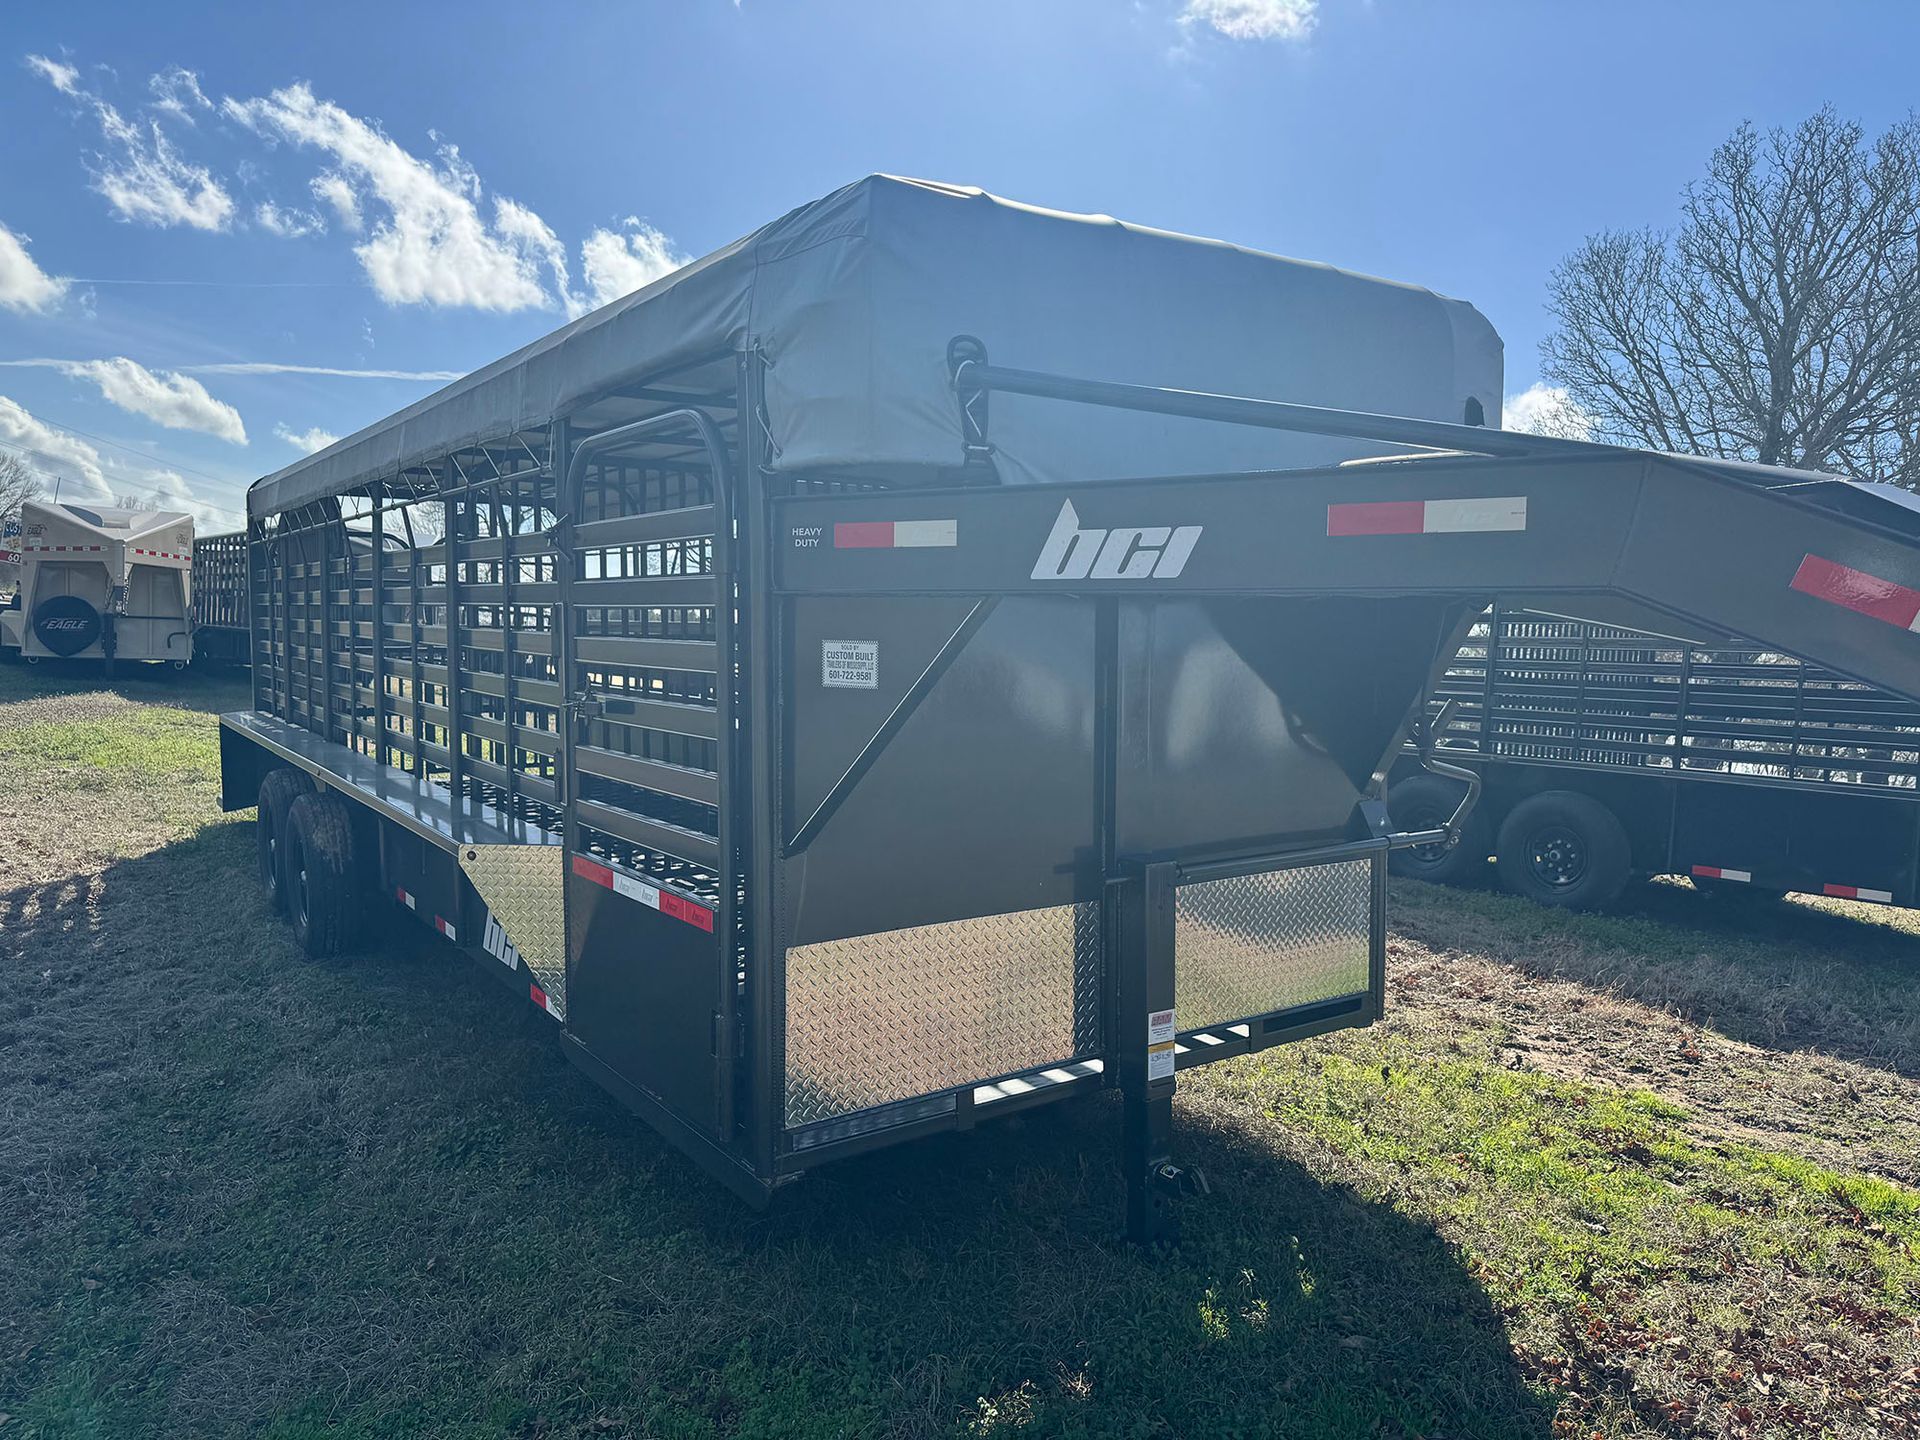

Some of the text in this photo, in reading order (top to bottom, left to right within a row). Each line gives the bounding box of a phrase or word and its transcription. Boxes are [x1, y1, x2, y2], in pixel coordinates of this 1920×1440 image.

[792, 527, 822, 536] HEAVY
[795, 539, 819, 547] DUTY
[46, 620, 88, 630] EAGLE
[826, 651, 874, 661] CUSTOM BUILT
[828, 670, 872, 681] 601-722-9581
